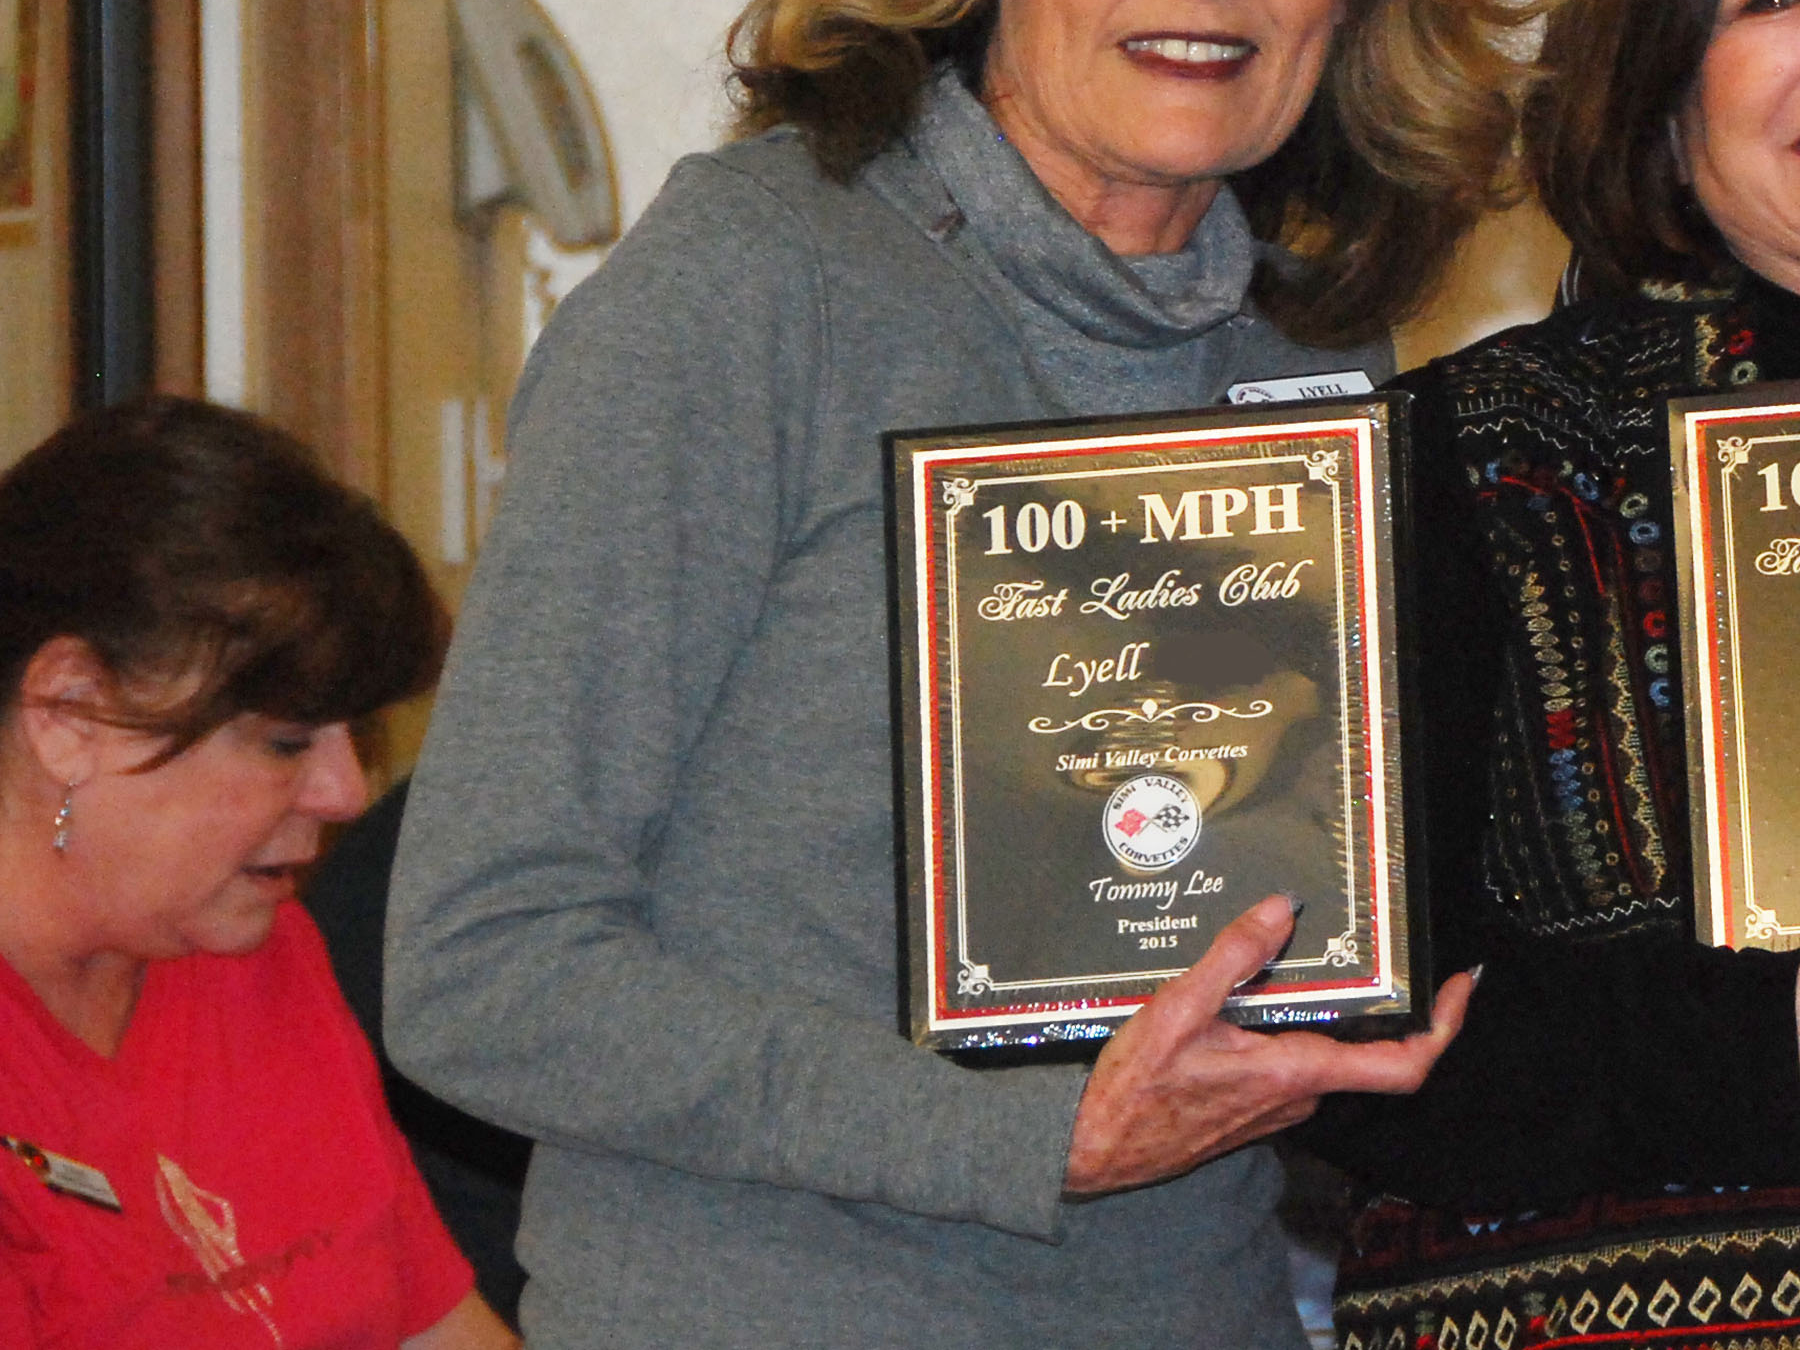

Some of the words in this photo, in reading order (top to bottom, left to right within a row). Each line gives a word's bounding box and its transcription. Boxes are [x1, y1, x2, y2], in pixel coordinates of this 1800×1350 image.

[1298, 384, 1348, 398] LYELL
[982, 501, 1086, 555] 100
[1101, 511, 1127, 532] +
[1138, 483, 1305, 543] MPH
[978, 581, 1069, 621] Fast
[1080, 570, 1201, 620] Ladies
[1219, 559, 1314, 606] Club
[1042, 643, 1149, 697] Lyell
[1056, 754, 1098, 771] Simi
[1104, 750, 1159, 768] Valley
[1165, 744, 1248, 762] Corvettes
[1112, 784, 1136, 810] SIMI
[1144, 778, 1188, 803] VALLEY
[1118, 836, 1189, 862] CORVETTES
[1090, 878, 1178, 910] Tommy
[1184, 870, 1223, 895] Lee
[1118, 915, 1198, 934] President
[1139, 935, 1178, 950] 2015
